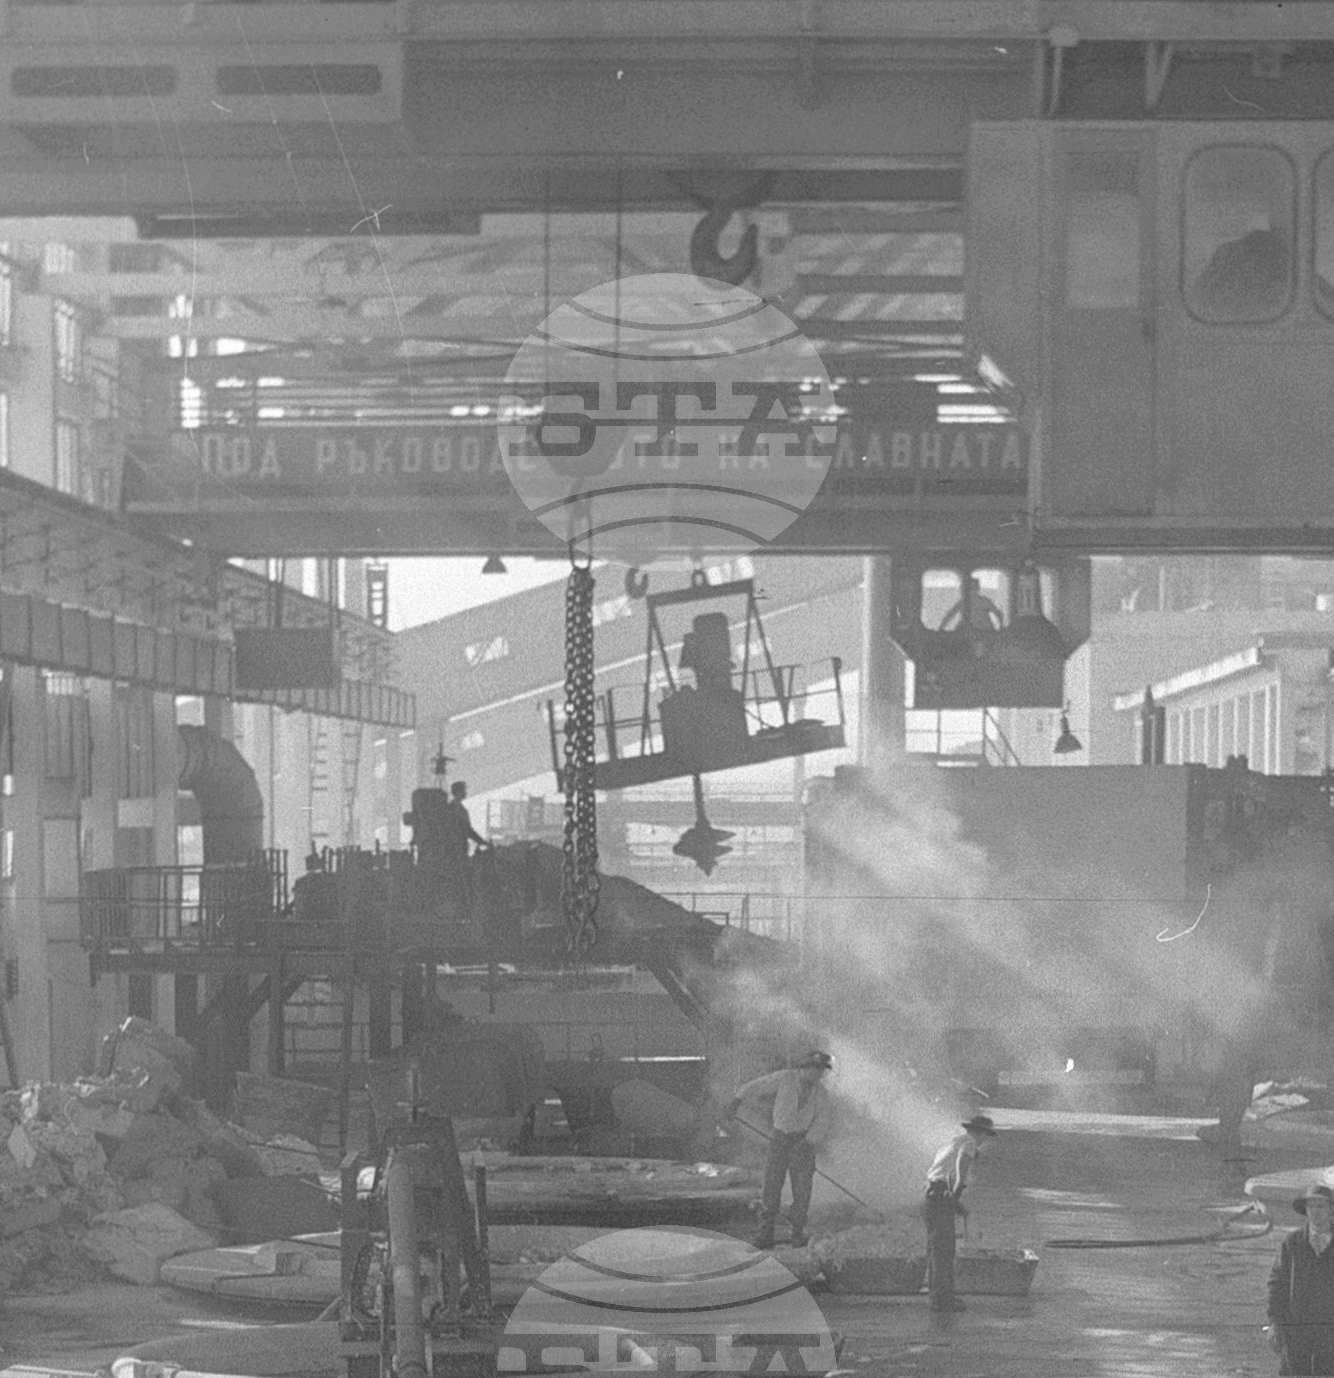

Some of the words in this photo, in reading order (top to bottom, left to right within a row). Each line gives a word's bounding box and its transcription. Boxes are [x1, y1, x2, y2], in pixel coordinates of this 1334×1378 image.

[201, 432, 282, 479] ПОД
[315, 436, 681, 475] РЪКОВОДСТО
[718, 433, 770, 471] НА
[803, 432, 1022, 470] СЛАВНАТА
